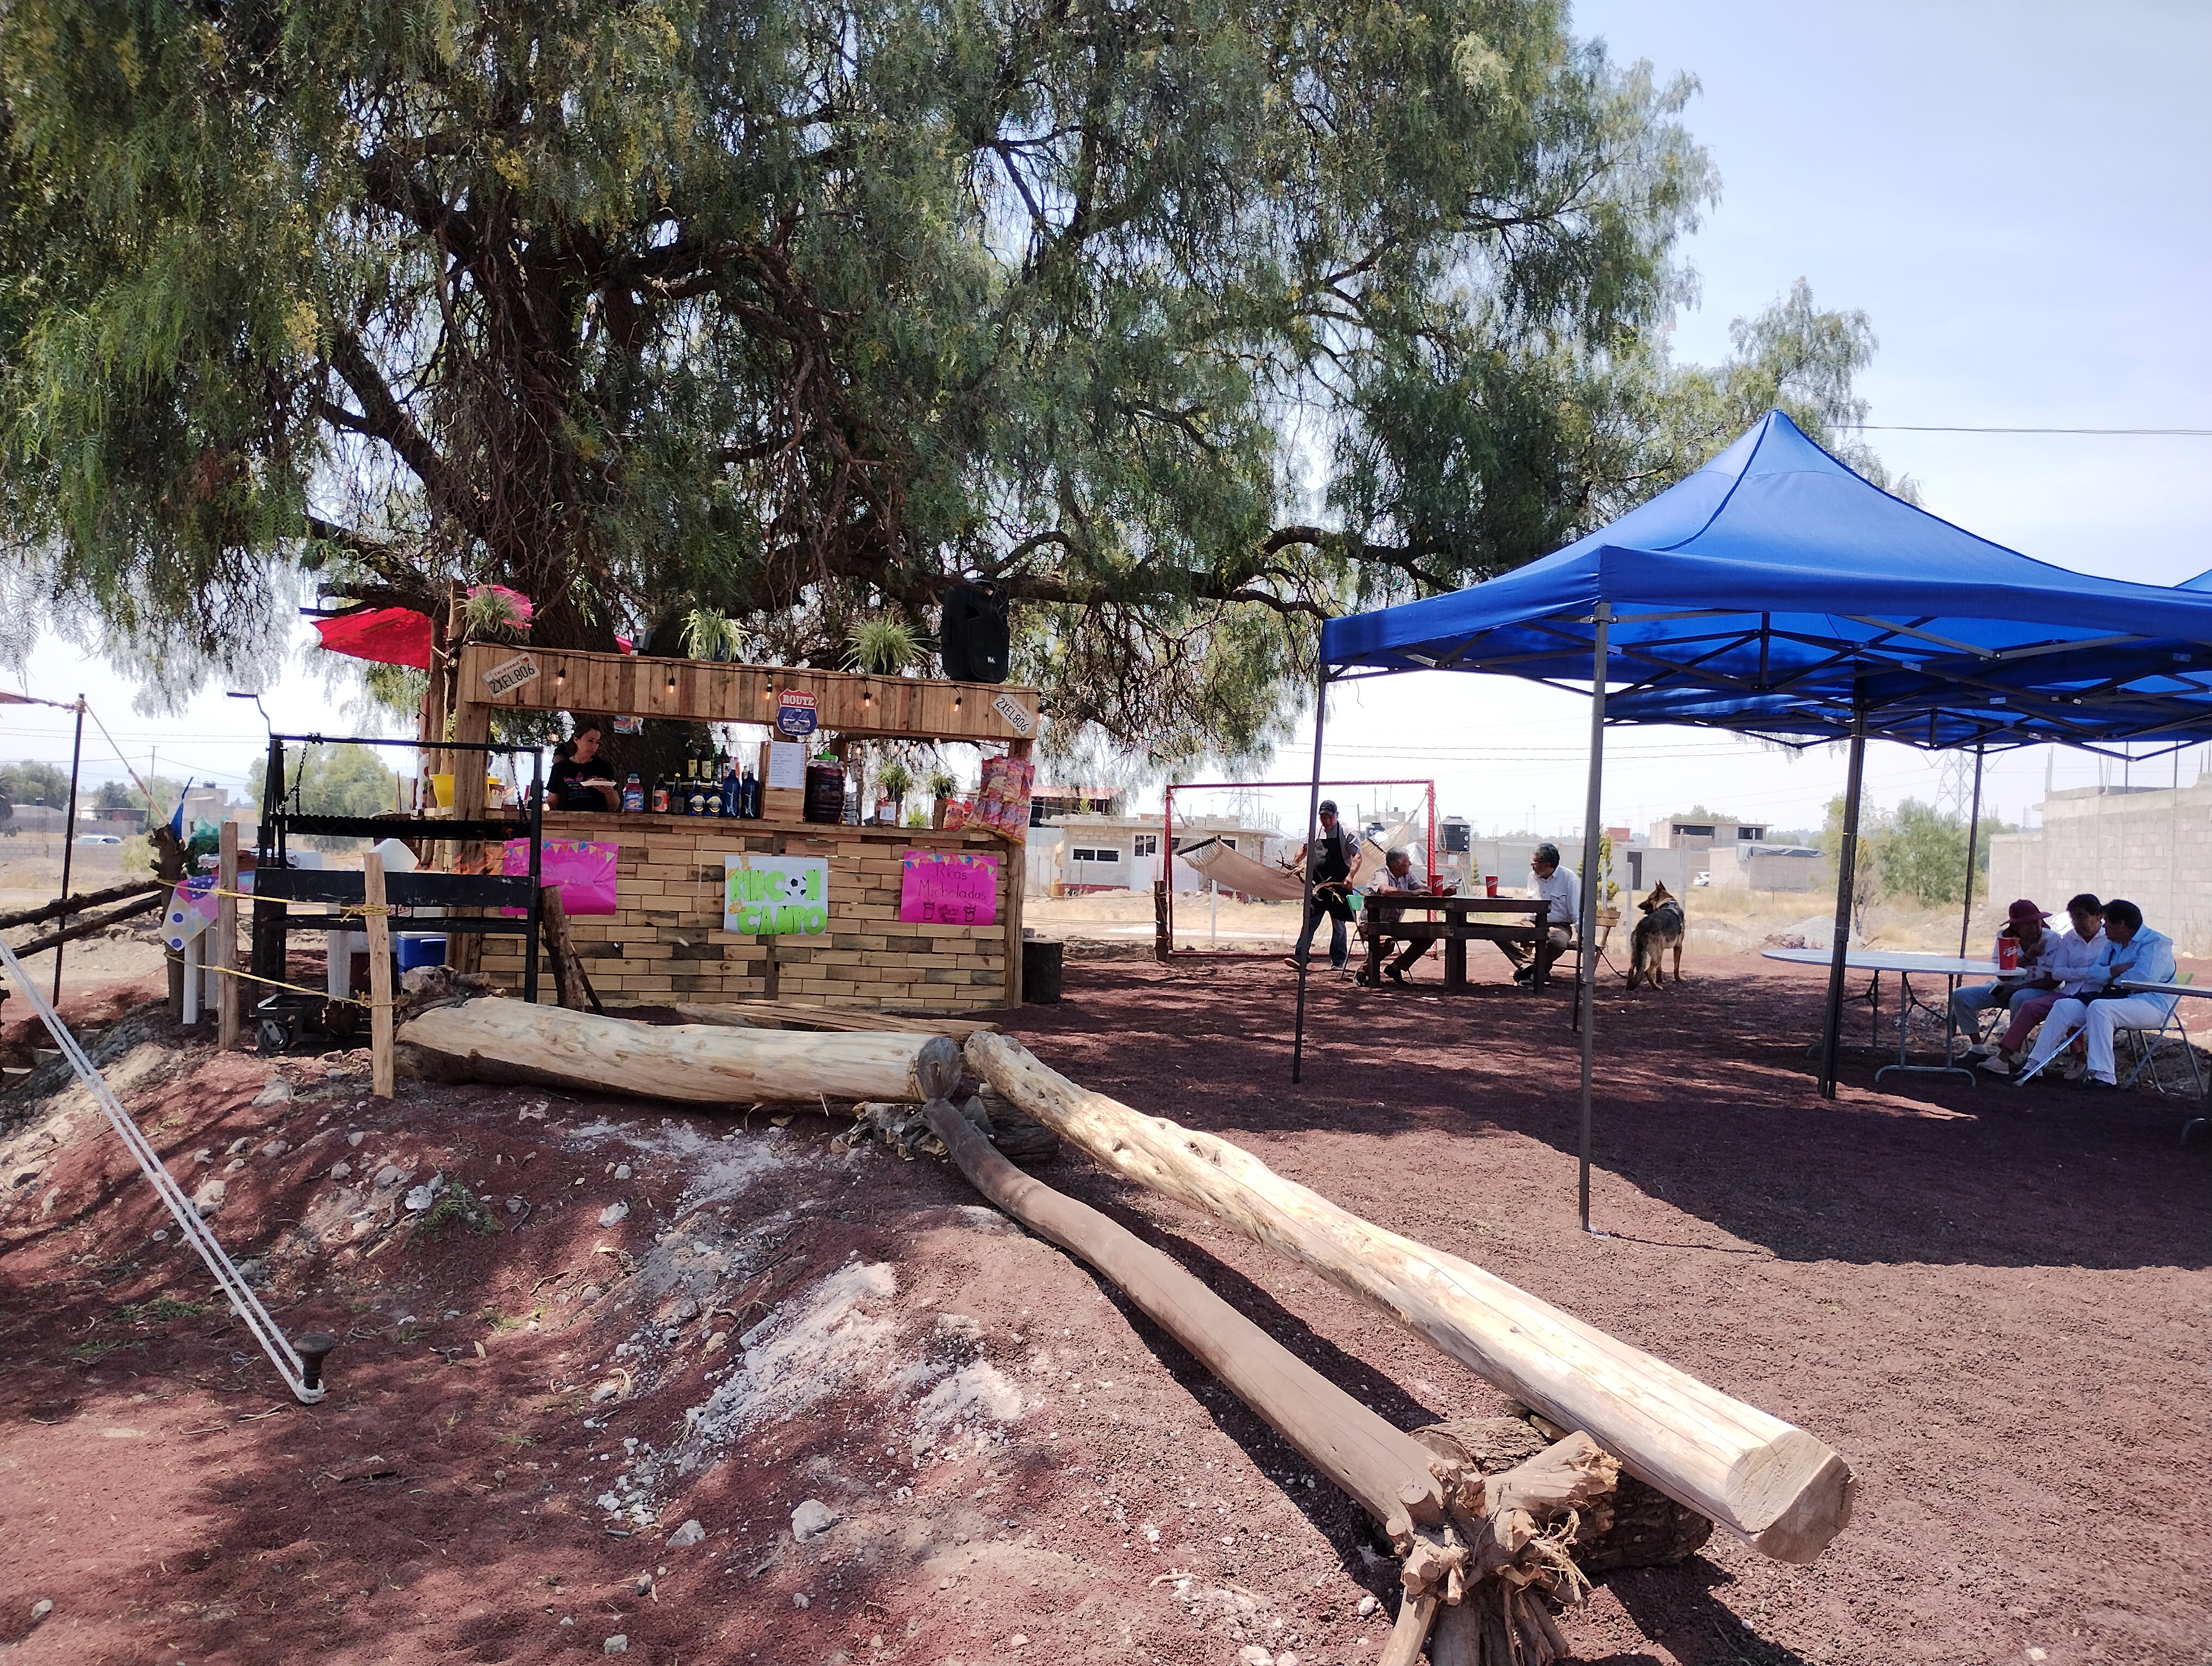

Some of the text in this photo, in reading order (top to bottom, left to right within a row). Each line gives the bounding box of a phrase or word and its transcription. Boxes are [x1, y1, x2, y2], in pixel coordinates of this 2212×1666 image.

[490, 663, 535, 694] 2XEL806
[782, 695, 814, 706] ROUTE
[783, 710, 811, 728] 66
[995, 697, 1030, 731] 2XEL806
[936, 862, 967, 880] Ricas
[918, 879, 987, 900] Micheladas
[737, 905, 827, 935] CAMPO
